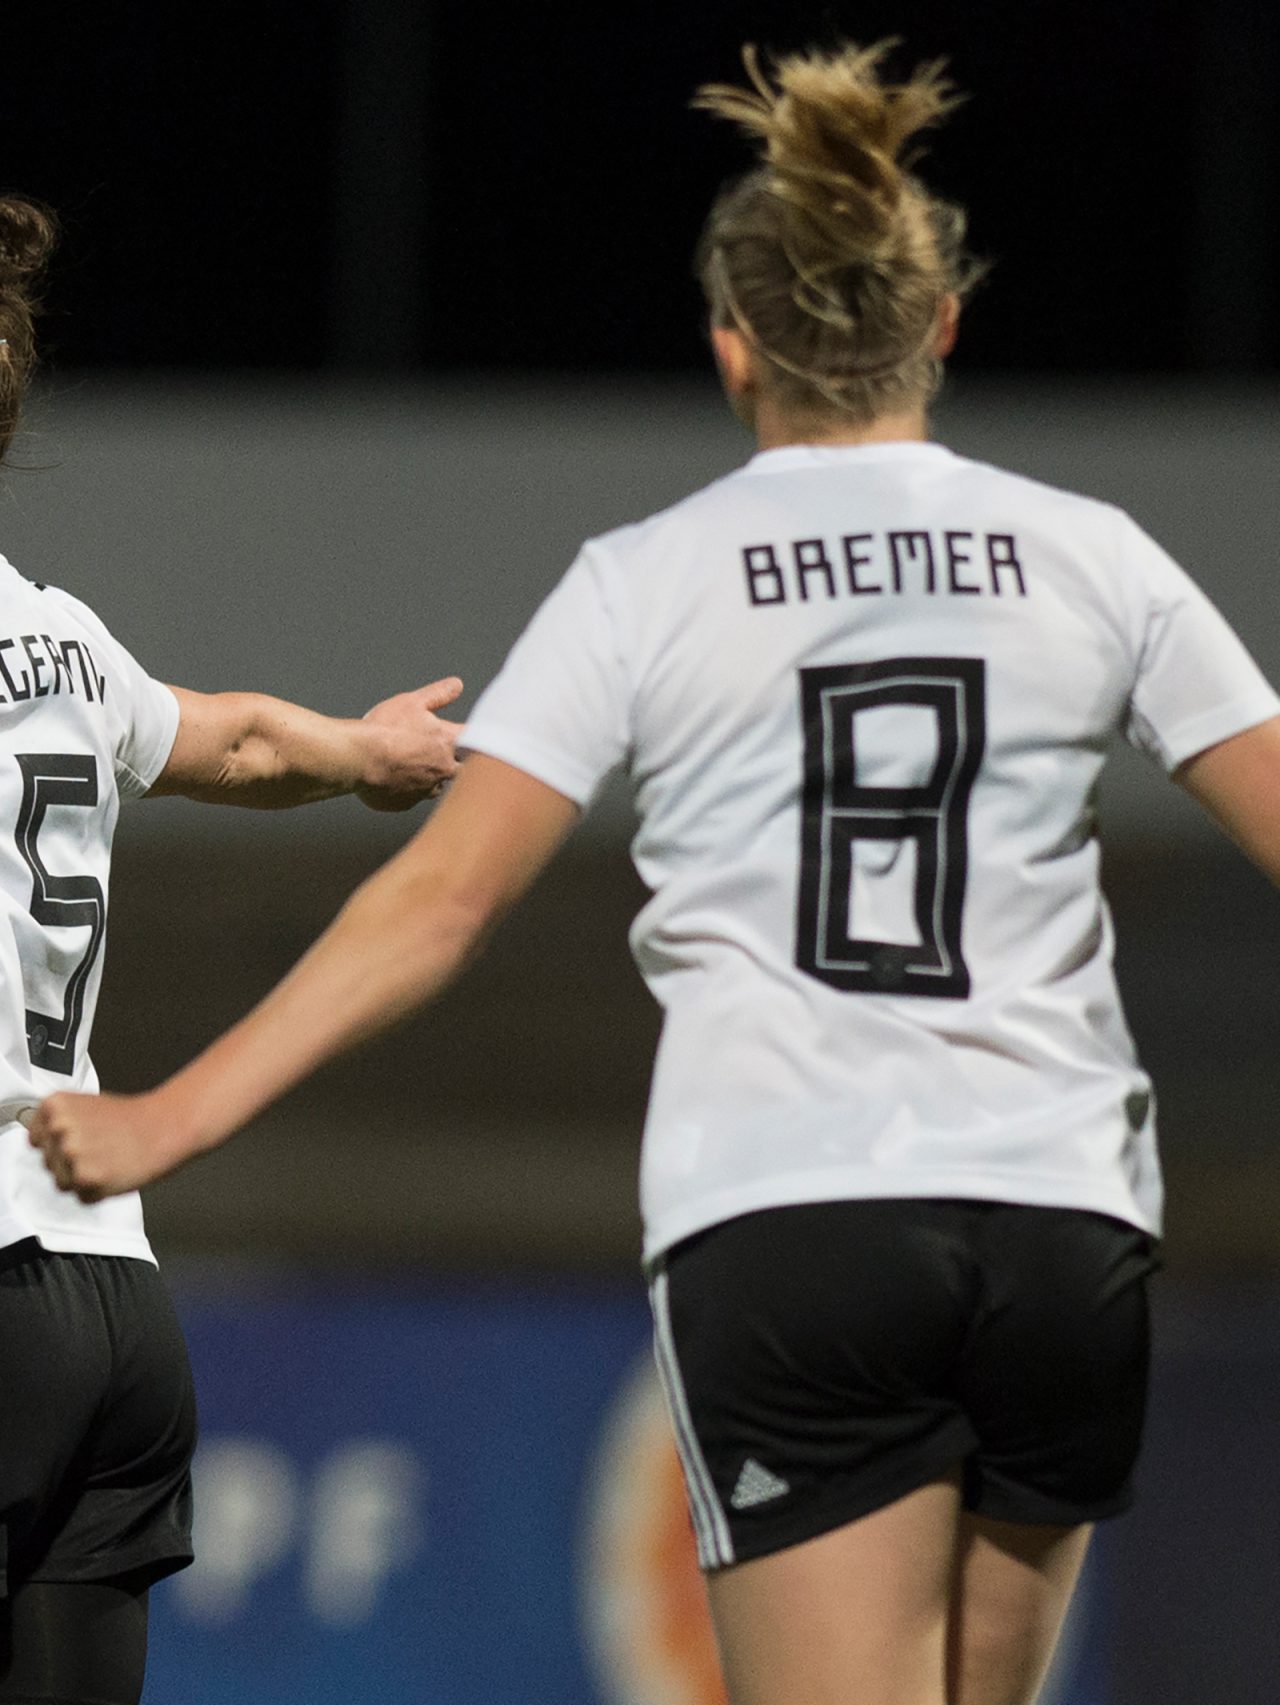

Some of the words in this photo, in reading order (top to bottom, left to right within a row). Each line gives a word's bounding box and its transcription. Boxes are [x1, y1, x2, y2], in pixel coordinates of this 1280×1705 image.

[742, 530, 1027, 608] BREMER
[14, 753, 105, 1077] 5
[794, 657, 987, 1001] 8
